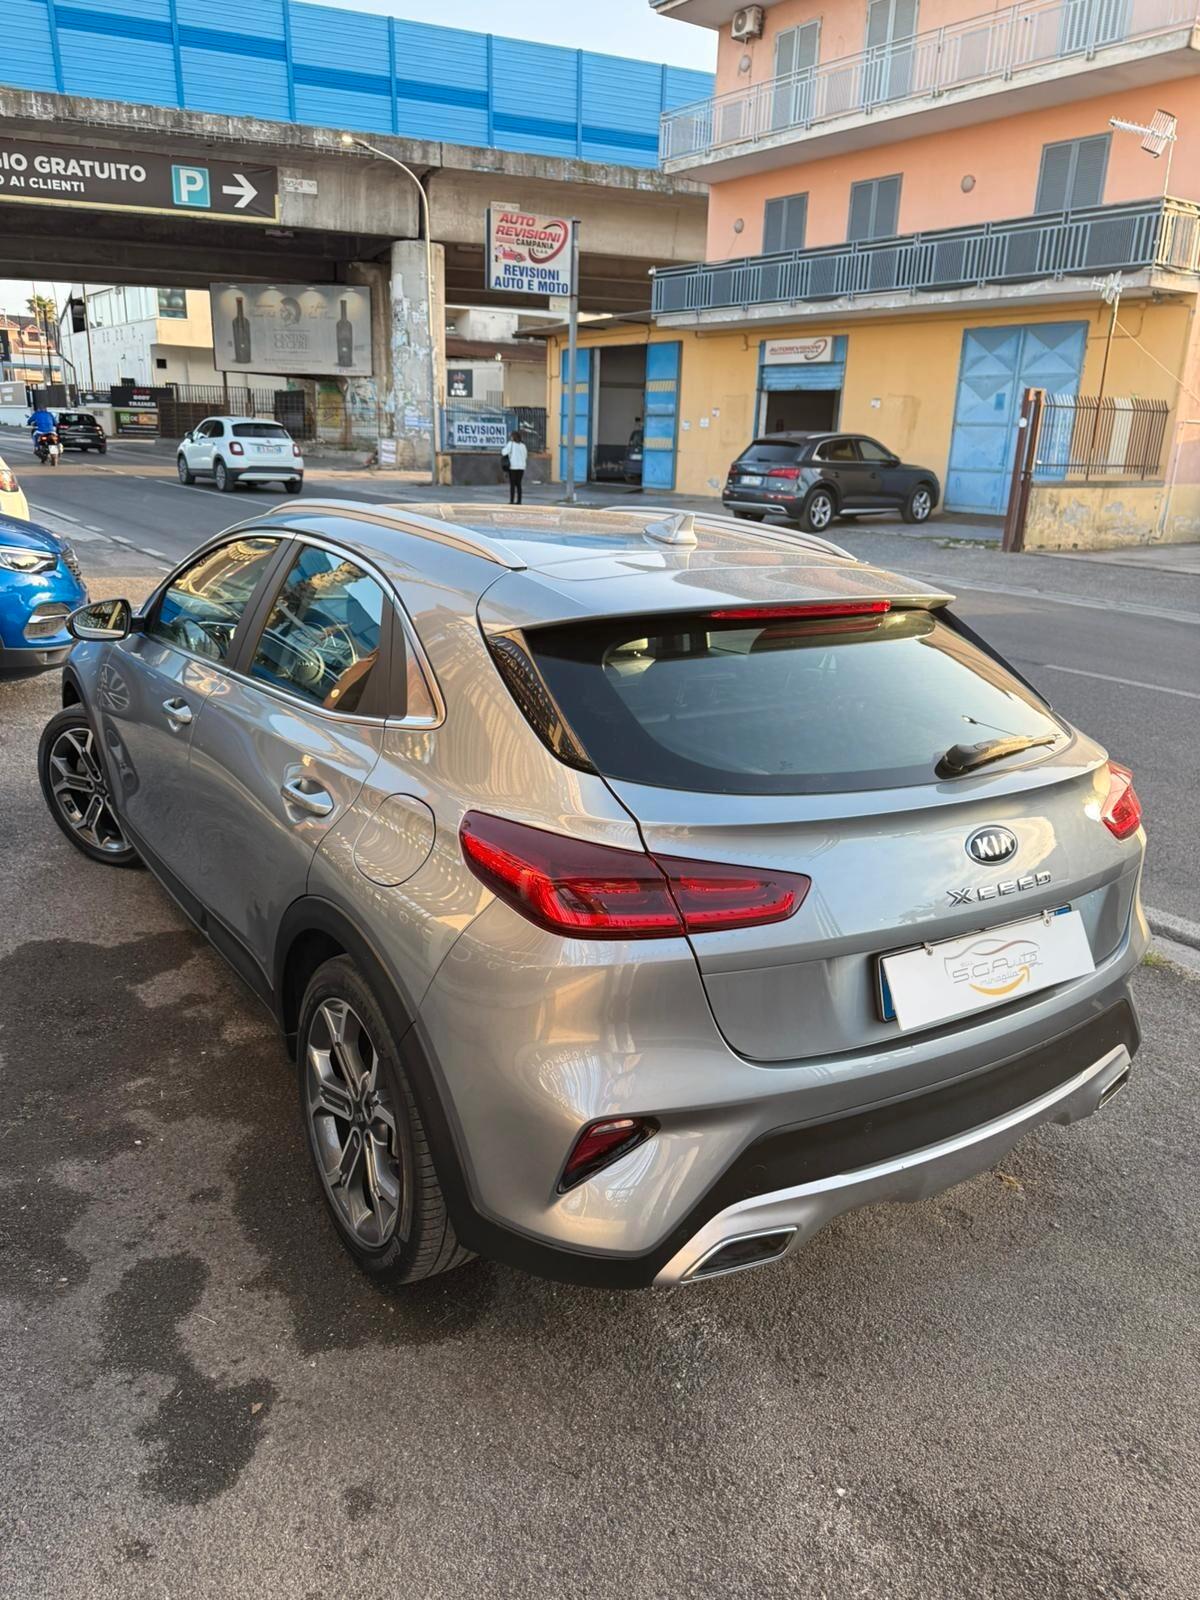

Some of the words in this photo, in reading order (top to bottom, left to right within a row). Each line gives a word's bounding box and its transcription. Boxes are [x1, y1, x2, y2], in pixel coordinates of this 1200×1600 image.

[0, 152, 28, 171] IO
[34, 155, 147, 183] GRATUITO
[9, 175, 25, 187] AI
[29, 177, 85, 193] CLIENTI
[179, 169, 204, 202] P
[499, 213, 537, 228] AUTO
[495, 225, 563, 244] REVISIONI
[515, 238, 555, 251] CAMPANIA
[504, 264, 560, 281] REVISIONI
[494, 275, 524, 291] AUTO
[527, 279, 535, 292] E
[538, 281, 569, 295] MOTO
[457, 424, 506, 436] REVISIONI
[456, 435, 478, 445] AUTO
[485, 436, 506, 444] MOTO
[975, 833, 1014, 858] KIA
